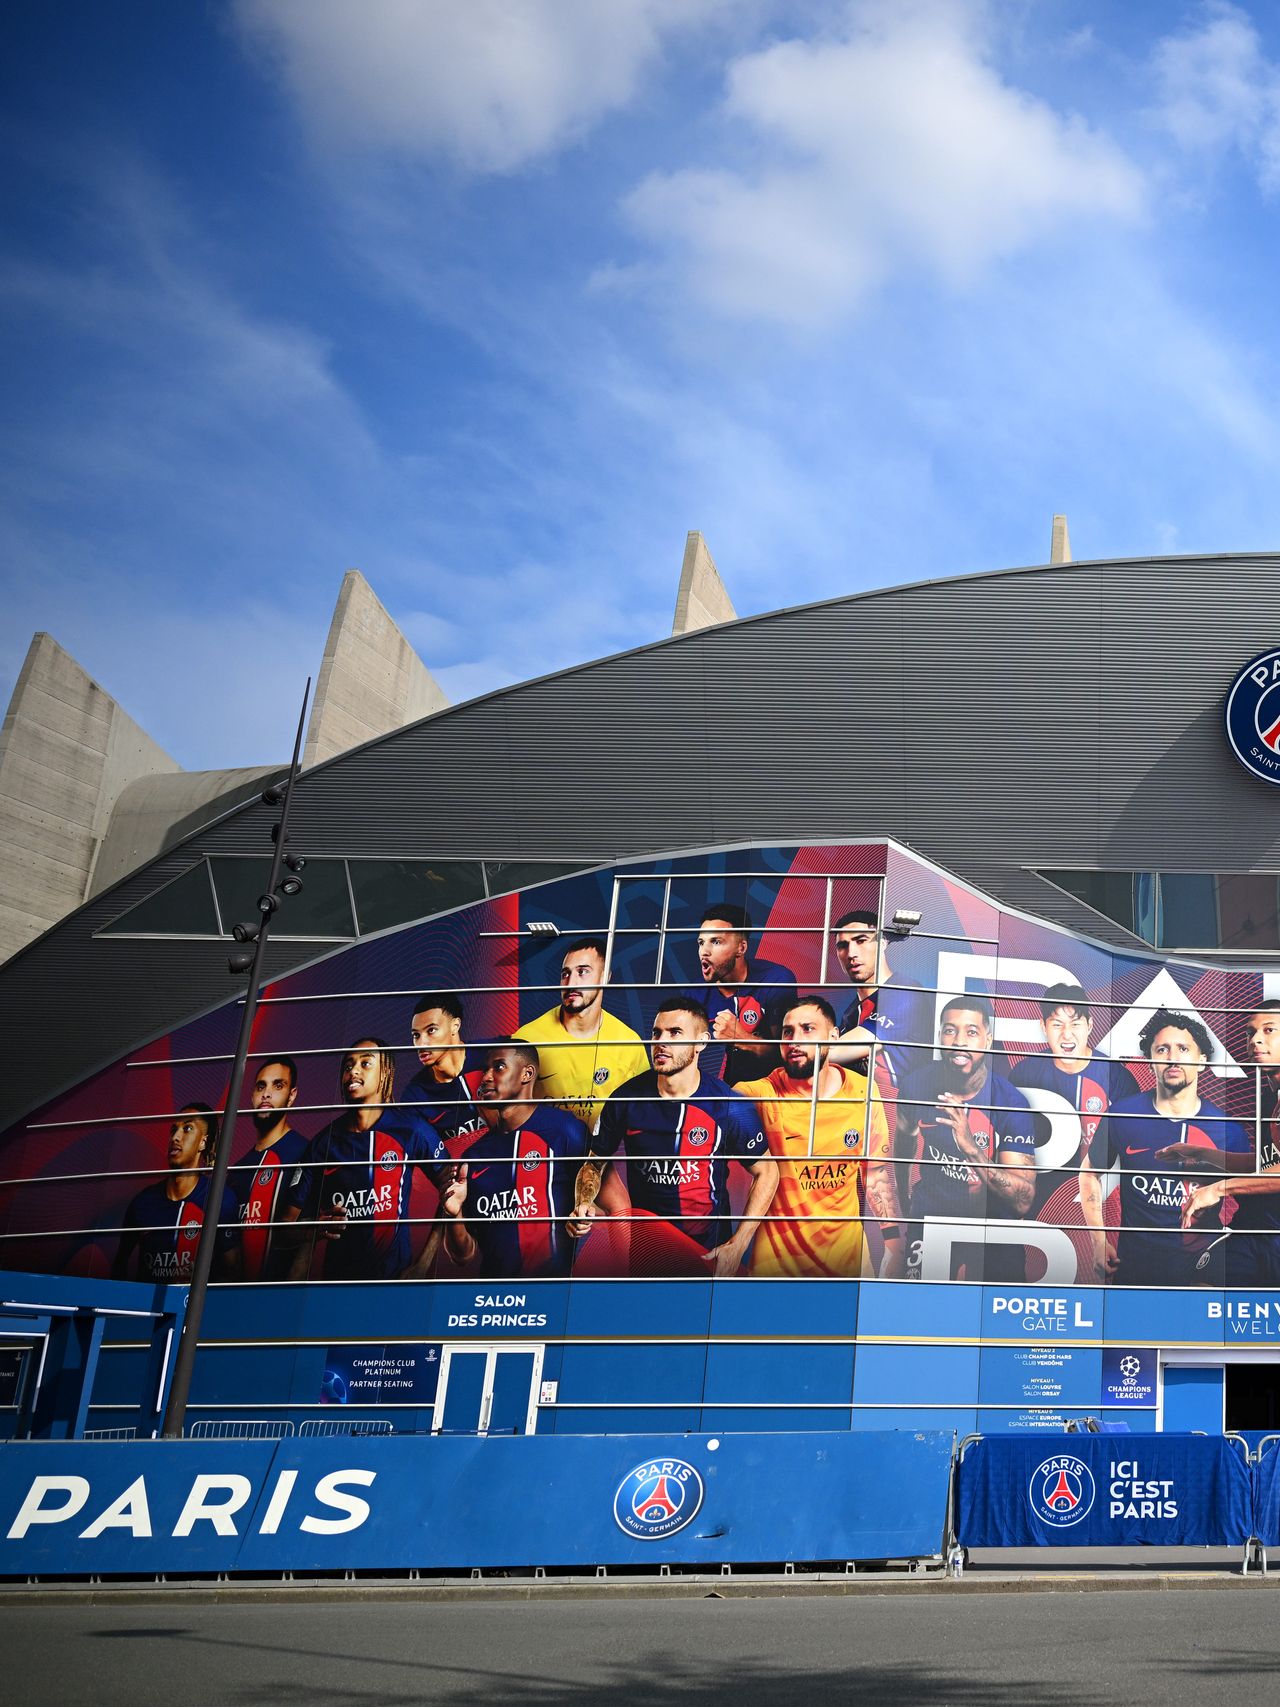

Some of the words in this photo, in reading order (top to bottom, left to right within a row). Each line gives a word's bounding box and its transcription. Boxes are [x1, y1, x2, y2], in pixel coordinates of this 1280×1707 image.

[647, 1172, 700, 1185] AIRWAYS
[333, 1184, 392, 1208] QATAR
[477, 1186, 538, 1216] QATAR
[1148, 1194, 1190, 1207] AIRWA
[345, 1199, 393, 1219] AIRWAYS
[490, 1204, 538, 1220] AIRWAYS
[474, 1295, 526, 1307] SALON
[992, 1297, 1067, 1315] PORTE
[448, 1314, 478, 1327] DES
[481, 1314, 547, 1327] PRINCES
[1074, 1302, 1093, 1327] L
[1022, 1316, 1067, 1332] GATE
[1108, 1385, 1152, 1393] CHAMPIONS
[634, 1462, 692, 1482] PARIS
[1040, 1459, 1084, 1477] PARIS
[1110, 1461, 1138, 1479] ICI
[1109, 1480, 1174, 1499] C'EST
[7, 1469, 377, 1539] PARIS
[1110, 1501, 1178, 1519] PARIS
